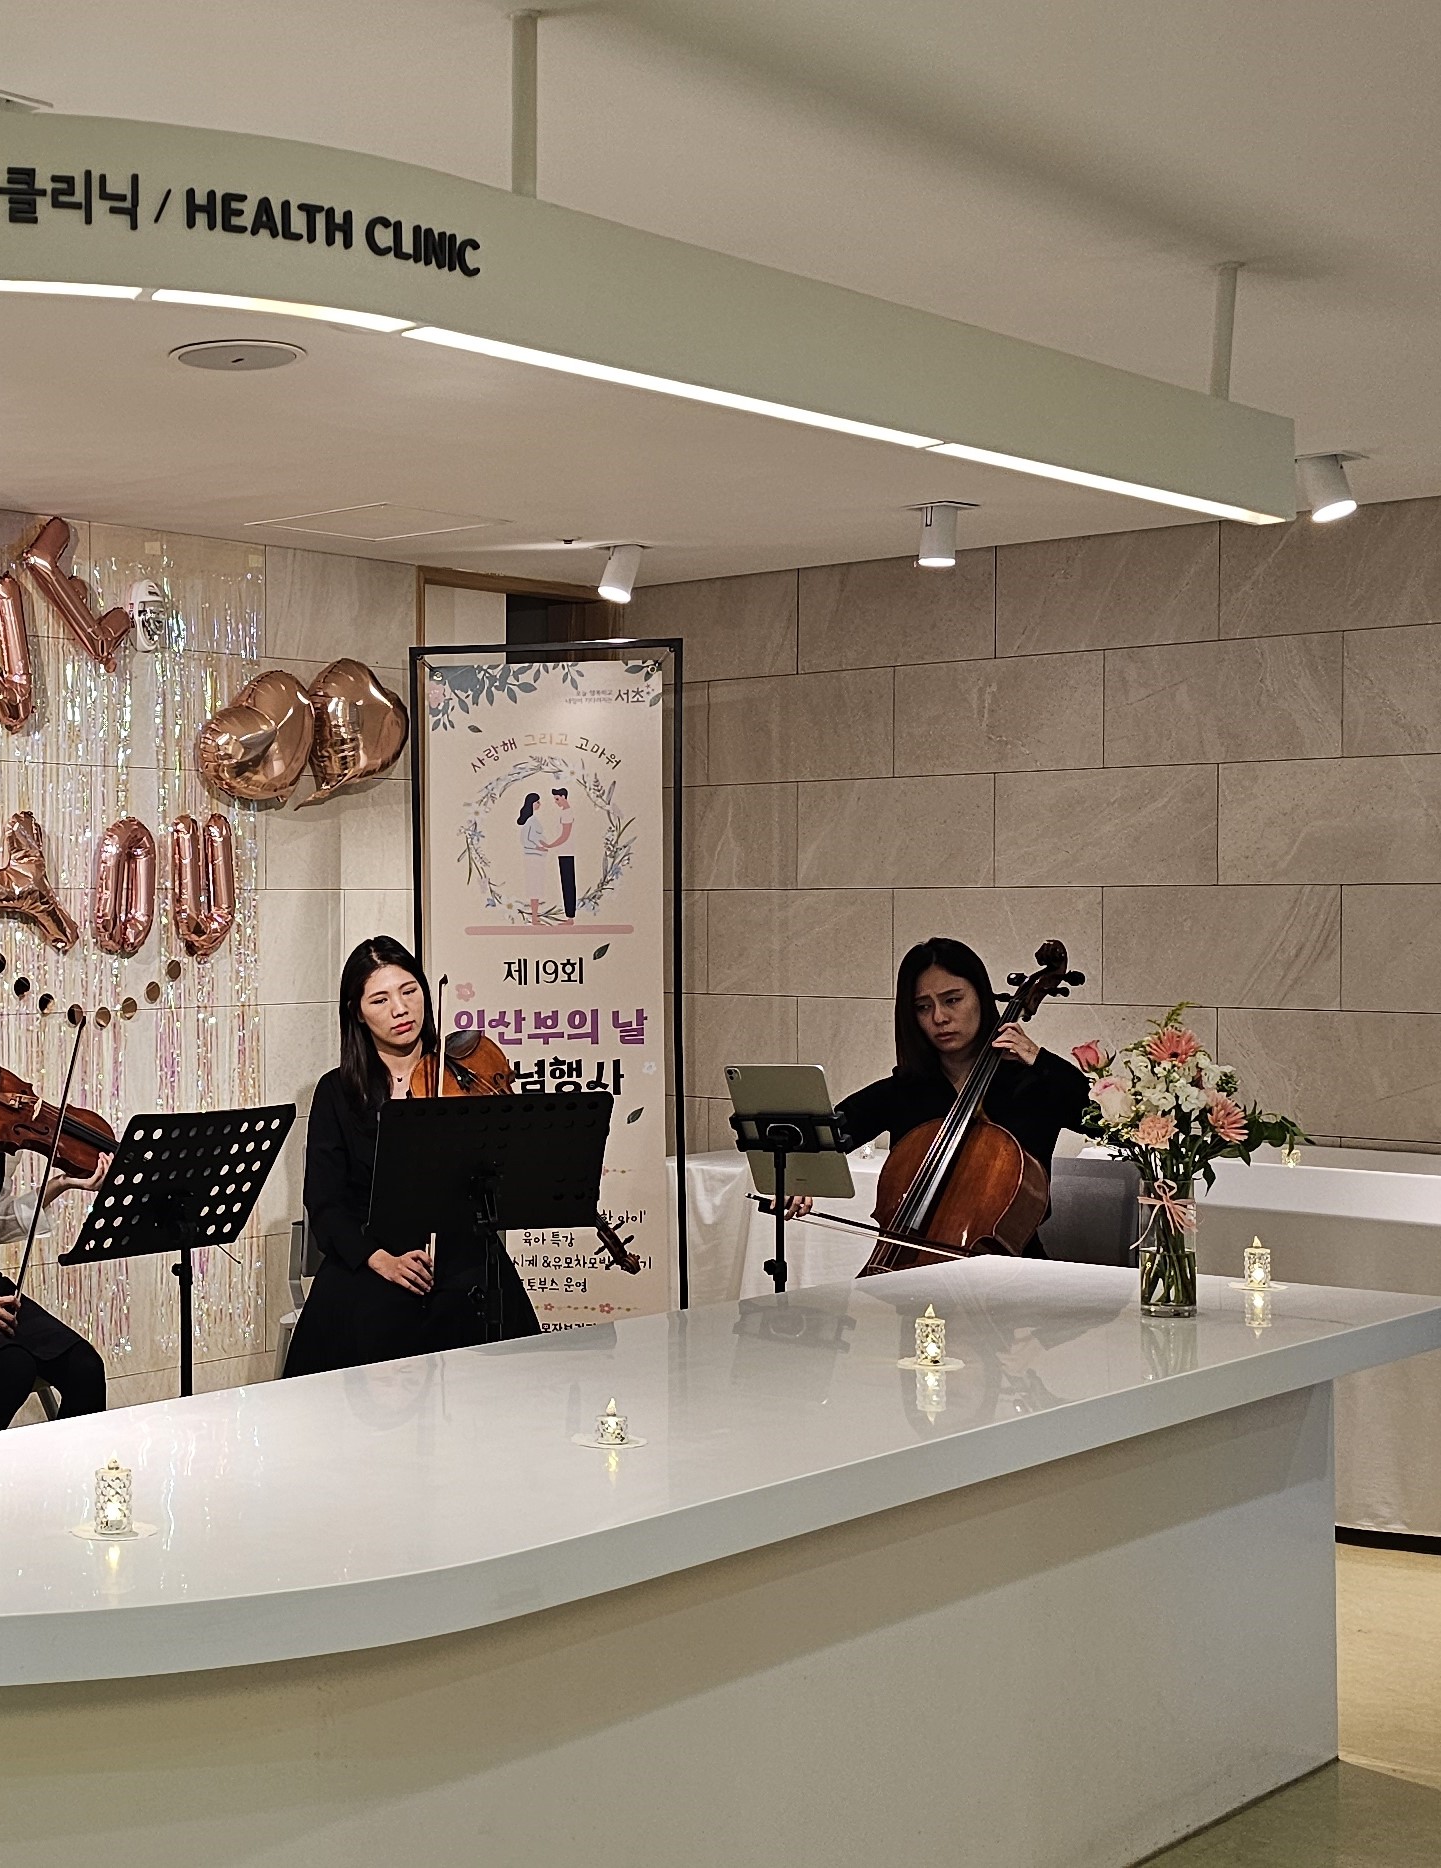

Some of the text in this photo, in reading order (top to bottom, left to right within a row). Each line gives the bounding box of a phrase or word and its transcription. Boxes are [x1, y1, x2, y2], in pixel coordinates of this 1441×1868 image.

[185, 187, 353, 250] HEALTH
[364, 216, 481, 277] CLINIC
[614, 687, 646, 704] 서초
[471, 733, 622, 773] 사랑해 그리고 고마워
[612, 1008, 648, 1045] 날
[507, 1056, 625, 1096] 념행사
[522, 1231, 575, 1247] 육아 특강
[521, 1277, 587, 1293] 토부스 운영
